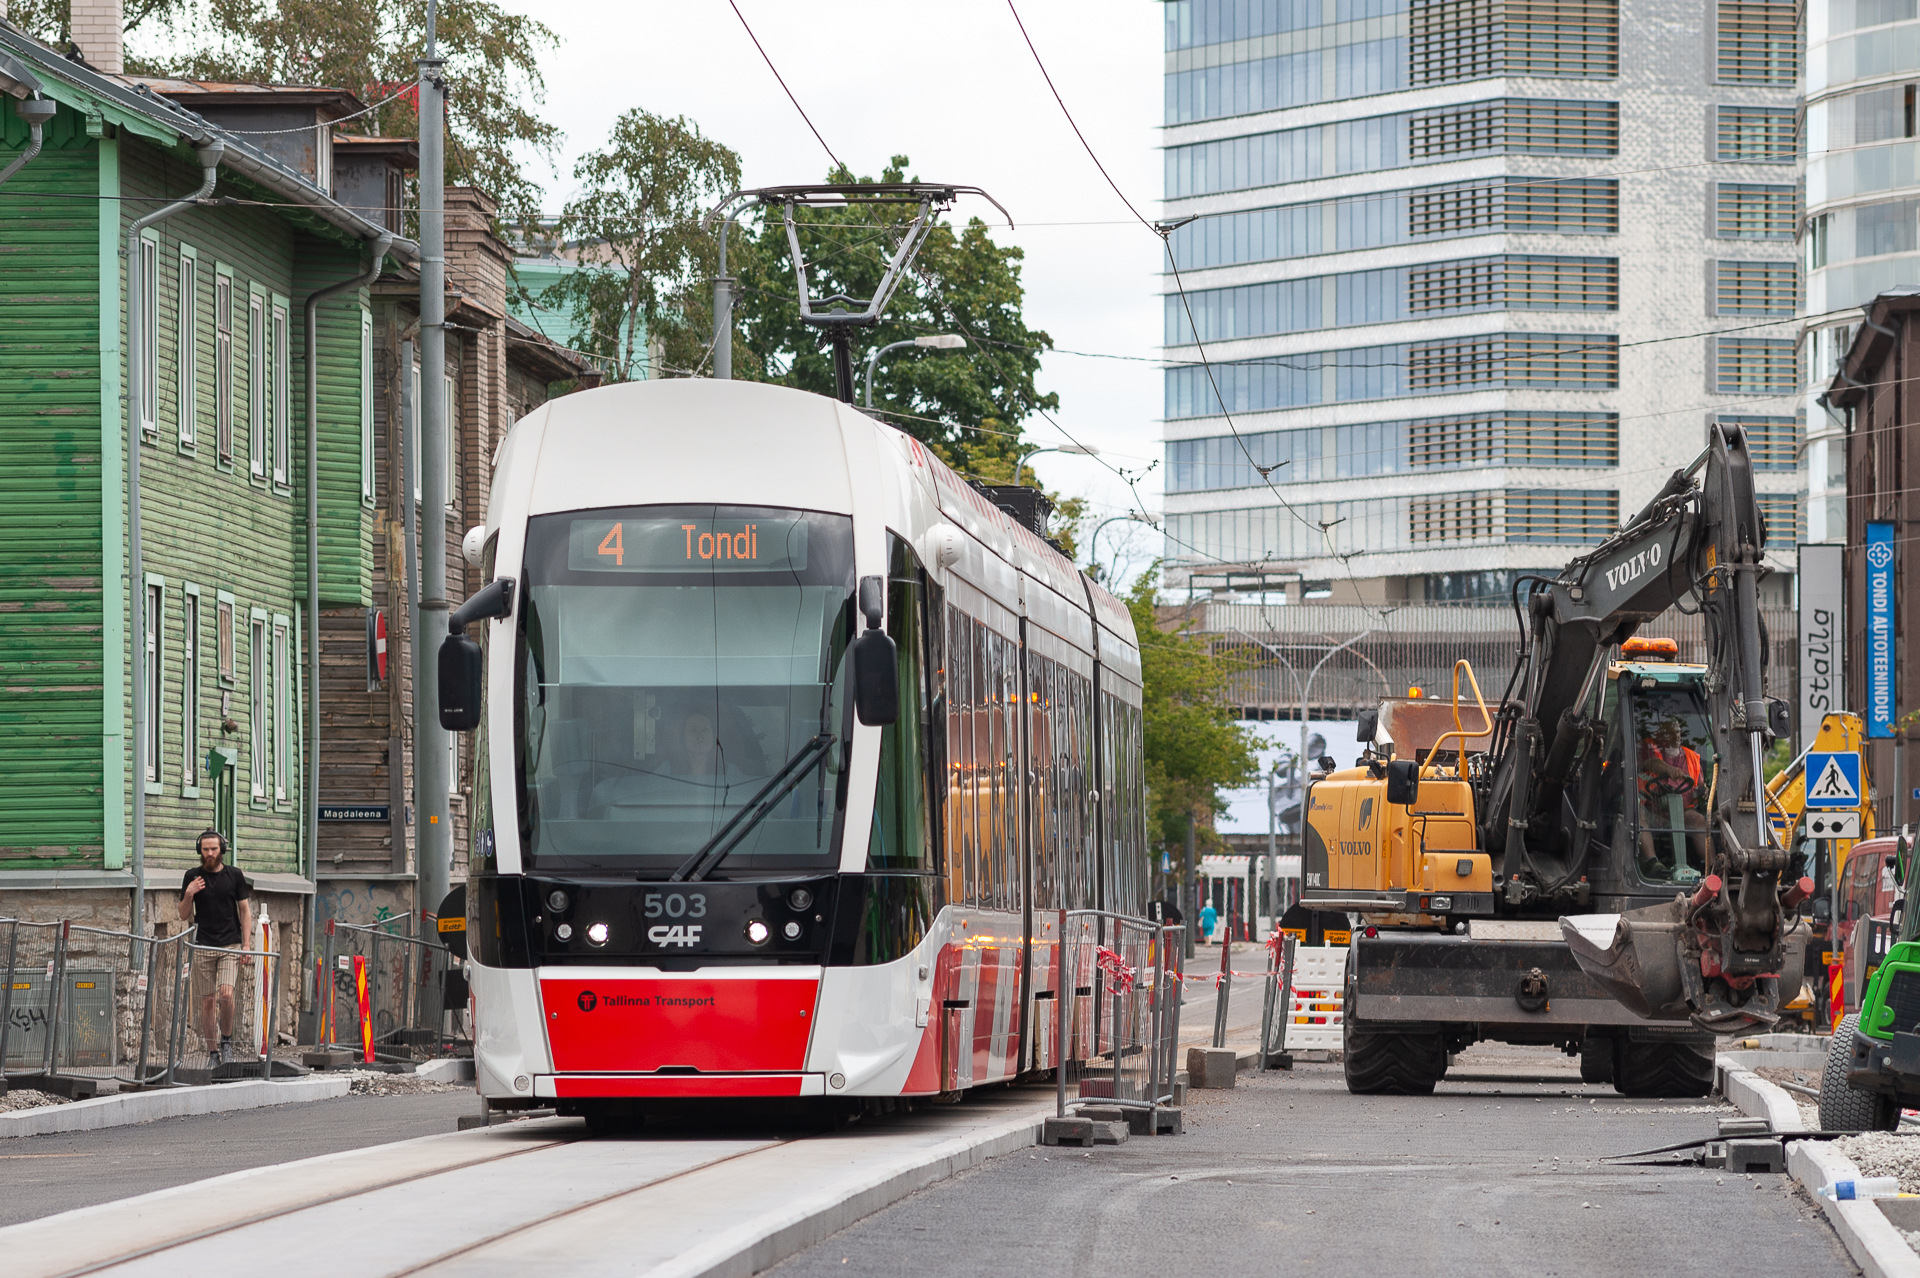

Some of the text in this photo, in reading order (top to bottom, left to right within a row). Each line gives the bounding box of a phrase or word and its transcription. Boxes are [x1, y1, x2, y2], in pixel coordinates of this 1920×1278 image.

[598, 522, 757, 566] 4 Tondi
[1605, 542, 1662, 592] VOLVO
[1872, 571, 1889, 722] TONDI AUTOTEENINDUS
[1808, 608, 1830, 711] Stalla
[323, 809, 382, 819] Magdaleena
[1339, 841, 1372, 856] VOLVO
[644, 893, 707, 918] 503
[647, 925, 703, 948] CAF
[602, 995, 715, 1008] Tallinna Transport
